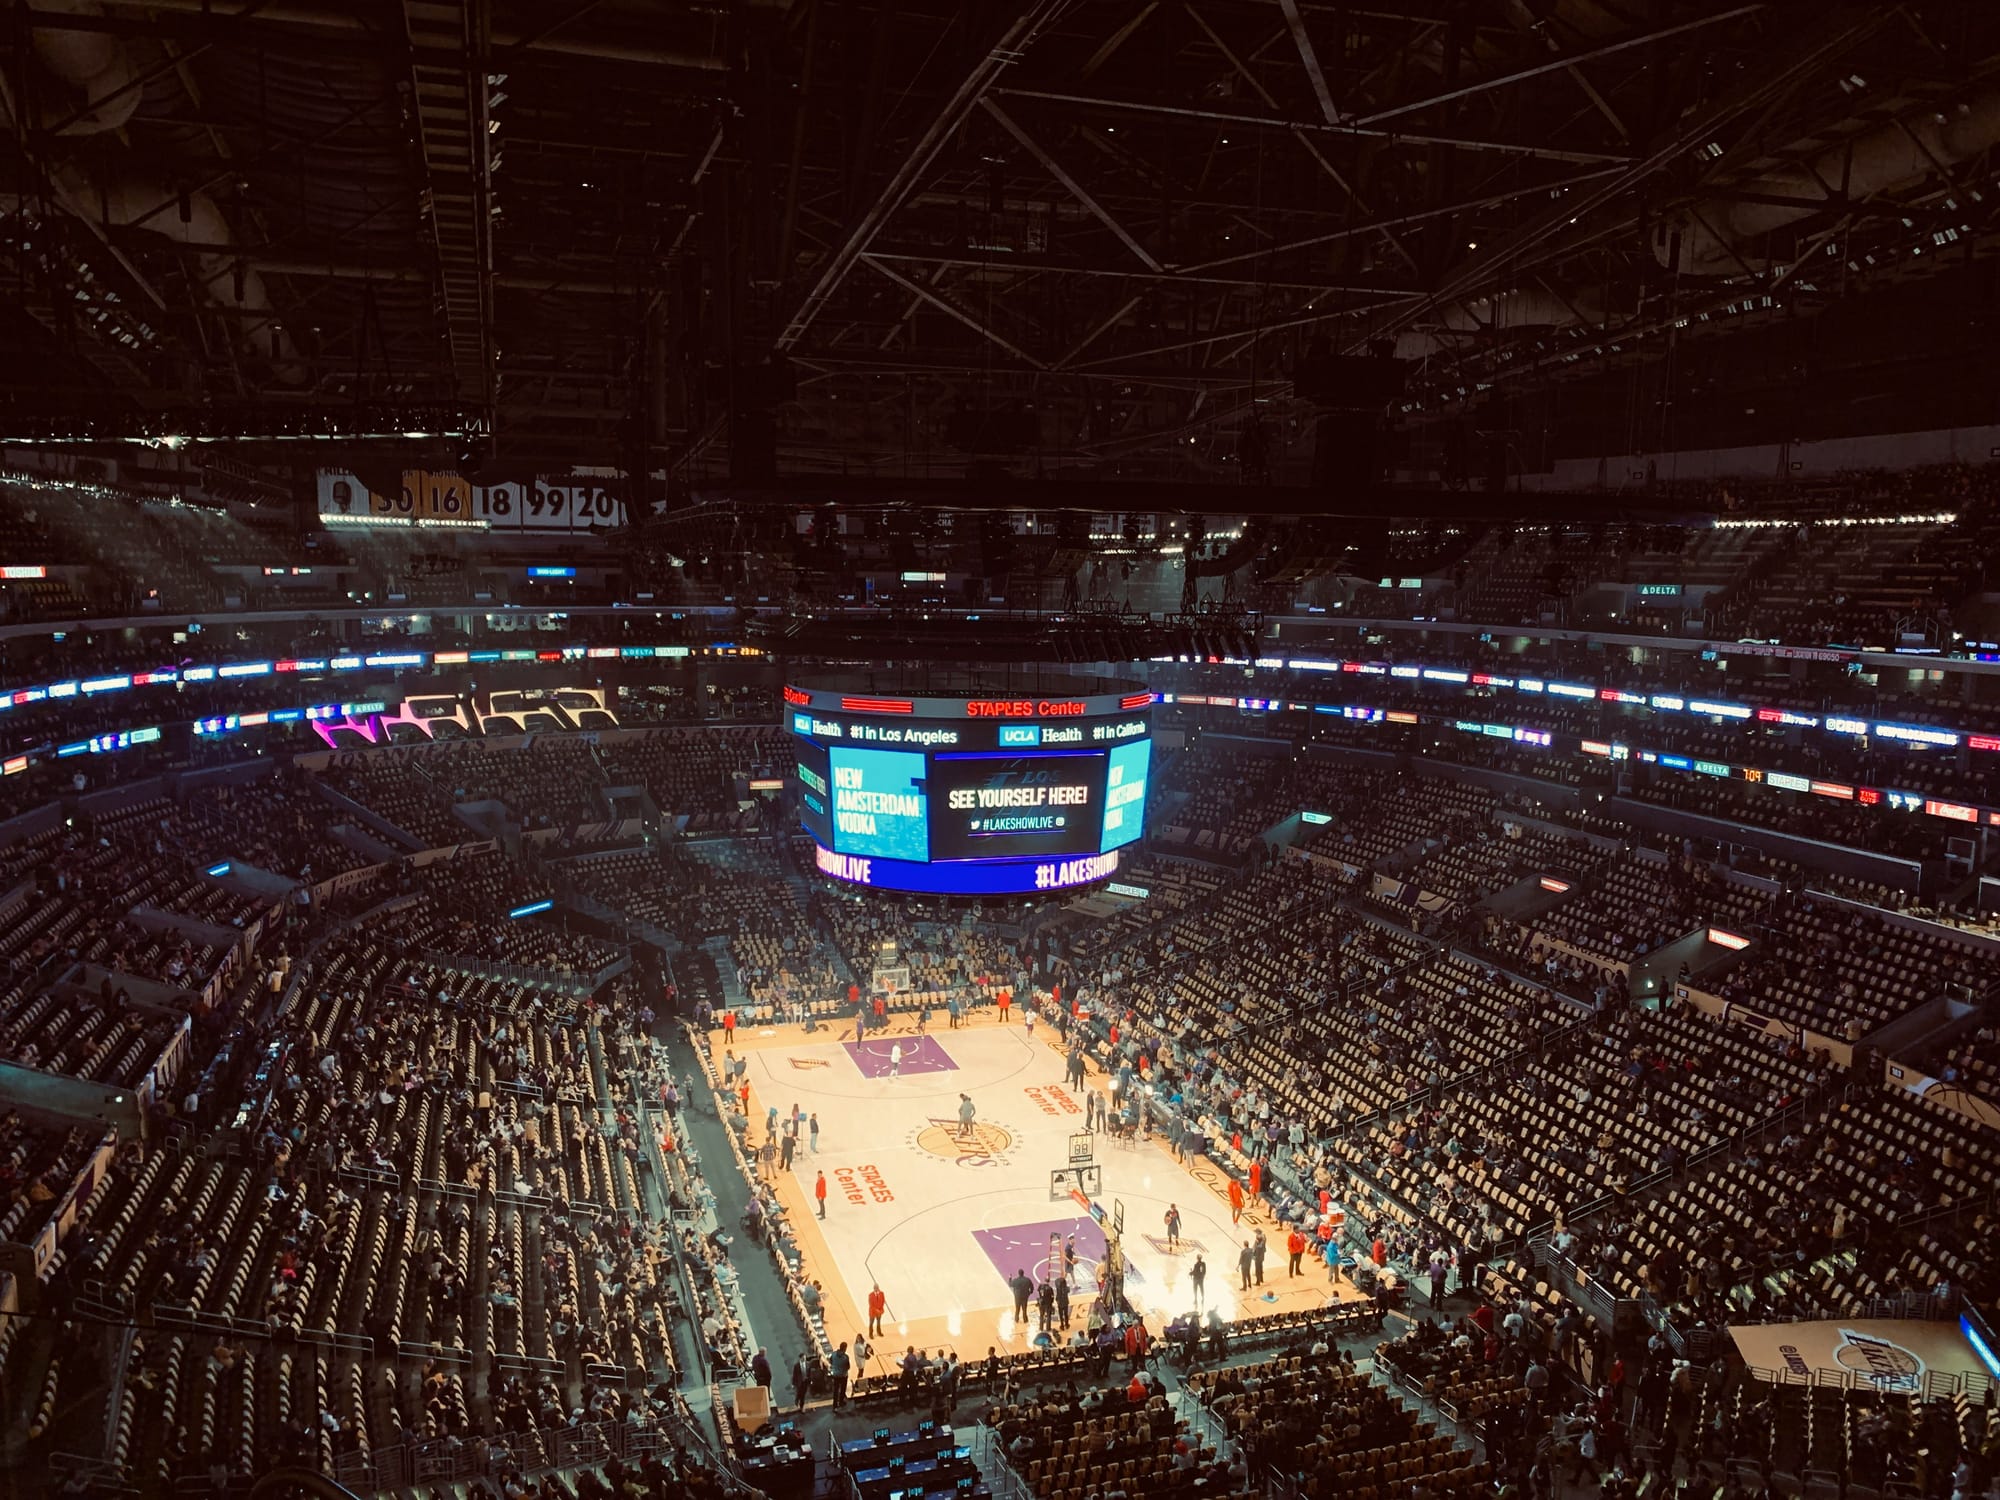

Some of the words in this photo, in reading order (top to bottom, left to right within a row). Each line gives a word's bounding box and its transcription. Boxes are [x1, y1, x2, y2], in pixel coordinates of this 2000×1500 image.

[431, 487, 460, 513] 16
[481, 488, 510, 516] 18
[535, 489, 565, 517] 99
[578, 491, 612, 518] 20
[1649, 587, 1676, 595] DELTA
[967, 701, 1033, 717] STAPLES
[1038, 701, 1086, 716] Center
[812, 719, 842, 737] Health
[850, 724, 864, 739] #1
[866, 725, 877, 740] in
[879, 727, 902, 742] Los
[904, 728, 957, 746] Angeles
[1004, 729, 1035, 743] UCLA
[1042, 728, 1083, 743] Health
[1092, 726, 1106, 740] #1
[1106, 725, 1115, 739] in
[1116, 720, 1146, 738] California
[1456, 720, 1482, 732] Spectrum
[834, 766, 863, 790] NEW
[1702, 764, 1728, 776] DELTA
[1769, 773, 1808, 790] STAPLES
[948, 790, 975, 810] SEE
[978, 787, 1047, 808] YOURSELF
[1048, 785, 1089, 806] HERE!
[837, 811, 877, 836] VODKA
[982, 815, 1053, 831] #LAKESHOWLIVE
[1023, 1086, 1061, 1117] Center
[1043, 1084, 1083, 1115] STAPLES
[834, 1167, 867, 1206] Center
[857, 1164, 895, 1203] STAPLES
